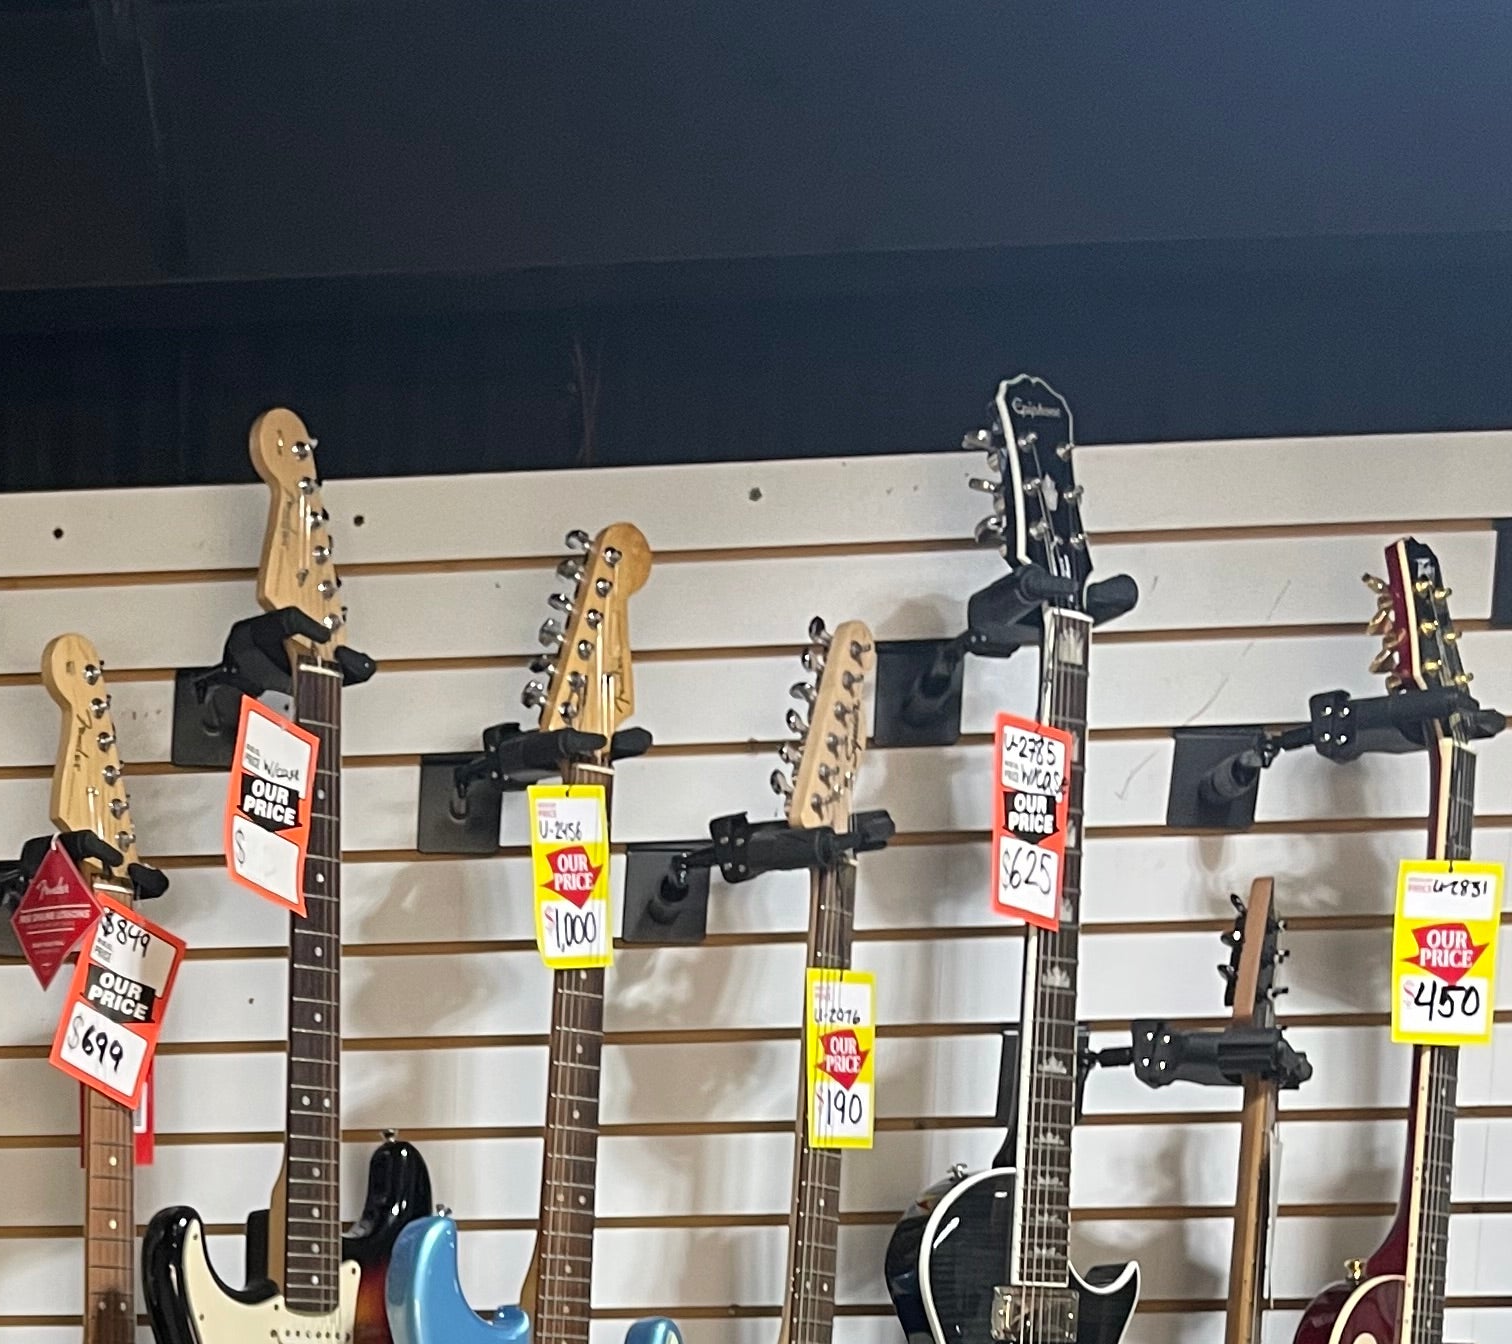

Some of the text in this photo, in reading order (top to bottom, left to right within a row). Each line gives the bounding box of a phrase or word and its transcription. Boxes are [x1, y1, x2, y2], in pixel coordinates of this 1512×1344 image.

[251, 779, 289, 806] OUR
[243, 795, 296, 826] PRICE
[1014, 793, 1048, 814] OUR
[1008, 811, 1054, 834] PRICE
[557, 854, 589, 872] OUR
[554, 873, 594, 891] PRICE
[1426, 929, 1468, 949] OUR
[1420, 948, 1473, 968] PRICE
[99, 973, 143, 1000] OUR
[88, 987, 149, 1021] PRICE
[67, 1015, 124, 1072] $699
[830, 1036, 857, 1055] OUR
[825, 1055, 860, 1073] PRICE
